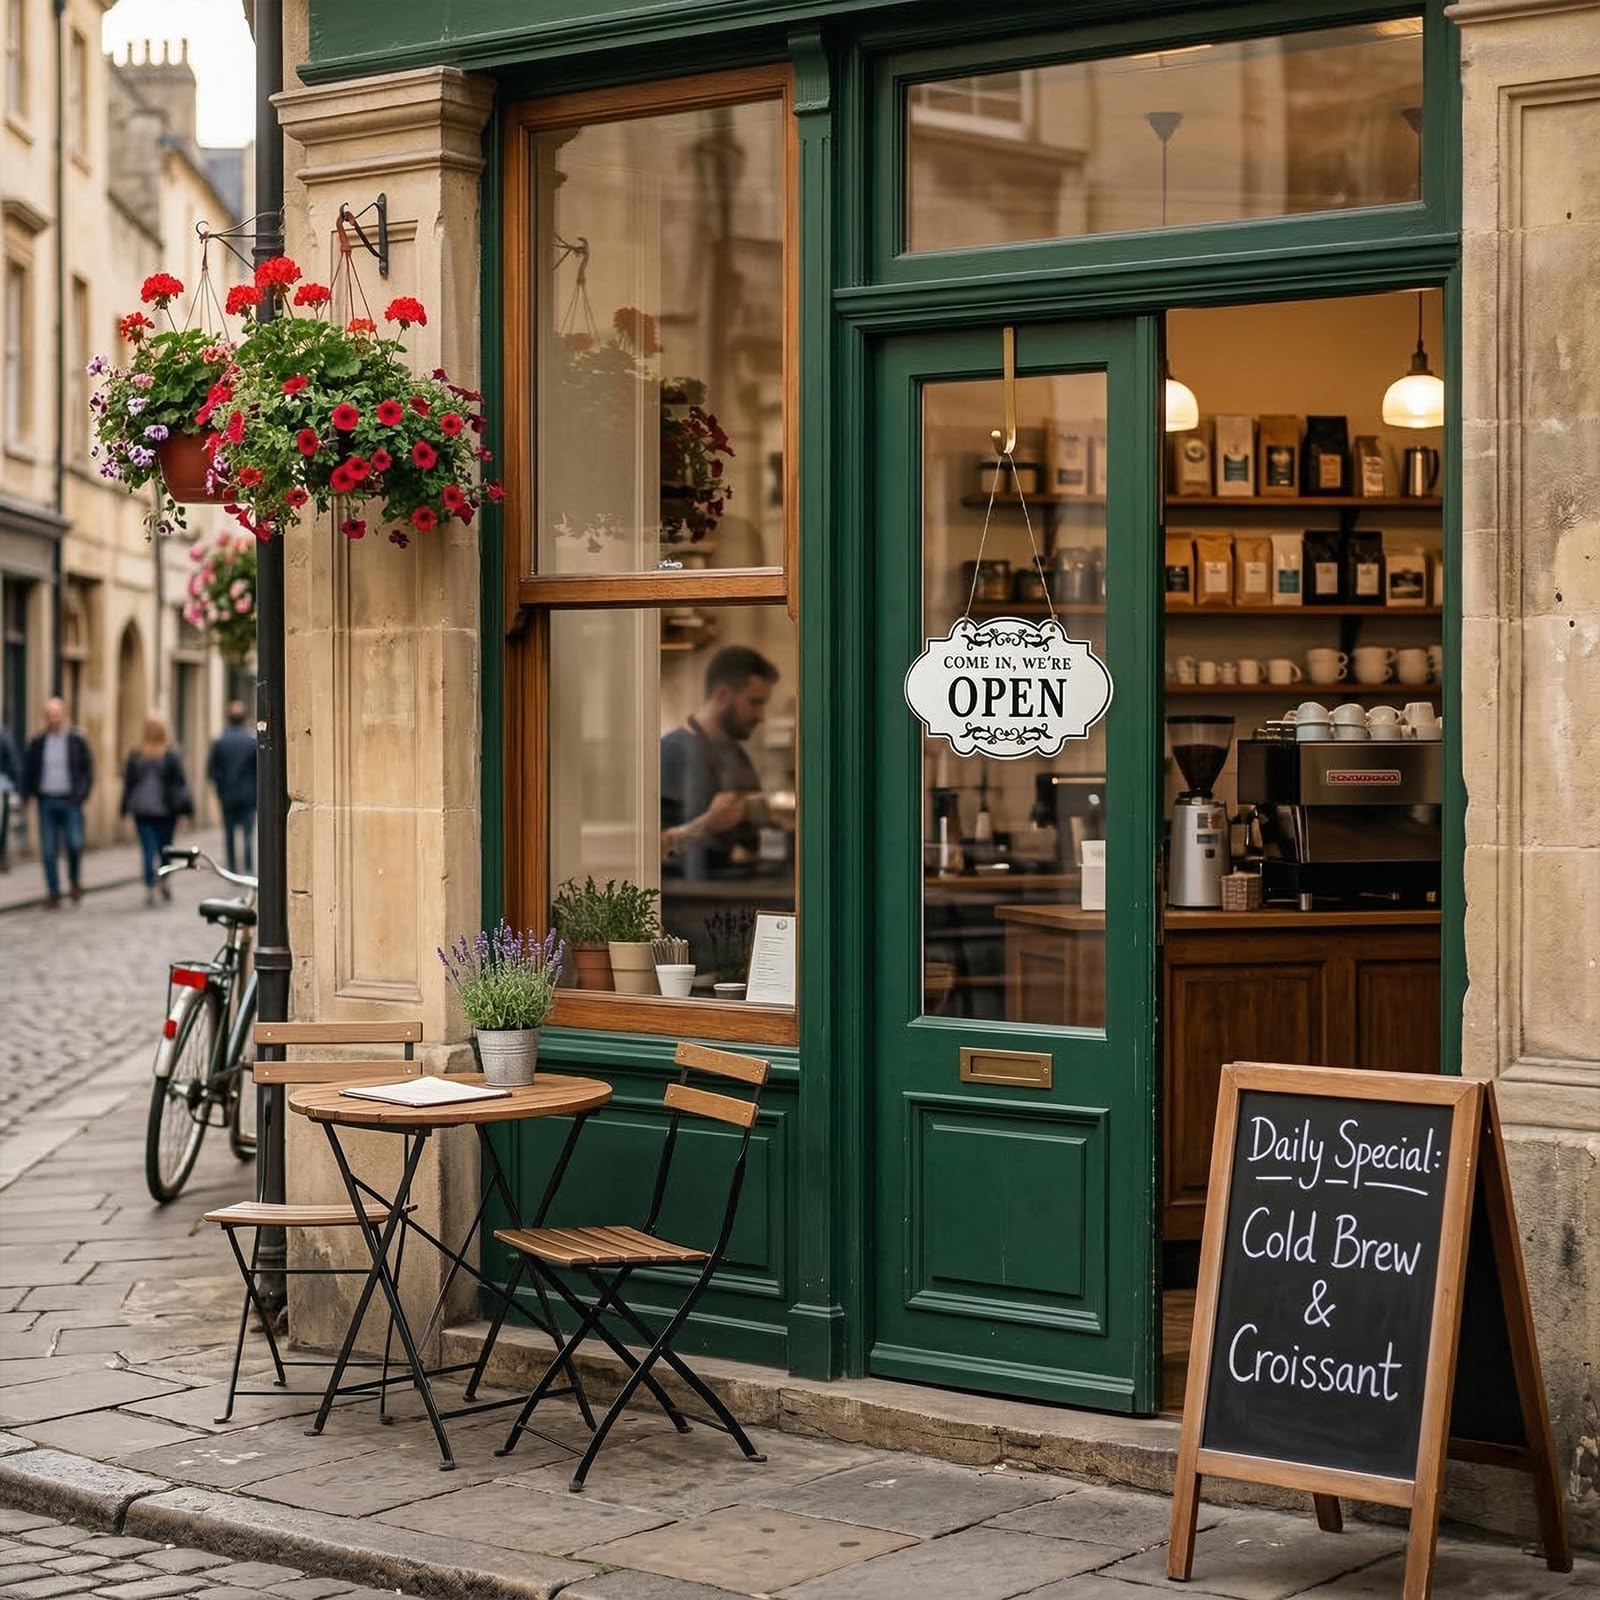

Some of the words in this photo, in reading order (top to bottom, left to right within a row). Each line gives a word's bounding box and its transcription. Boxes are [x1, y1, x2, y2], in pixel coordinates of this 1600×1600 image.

[944, 656, 989, 669] COME
[995, 657, 1016, 672] IN,
[1023, 656, 1072, 670] WE'RE
[948, 676, 1067, 718] OPEN
[1247, 1116, 1324, 1190] Daily
[1334, 1119, 1442, 1190] Special:
[1242, 1206, 1316, 1264] Cold
[1331, 1214, 1422, 1276] Brew
[1304, 1279, 1336, 1328] &
[1228, 1323, 1402, 1401] Croissant
